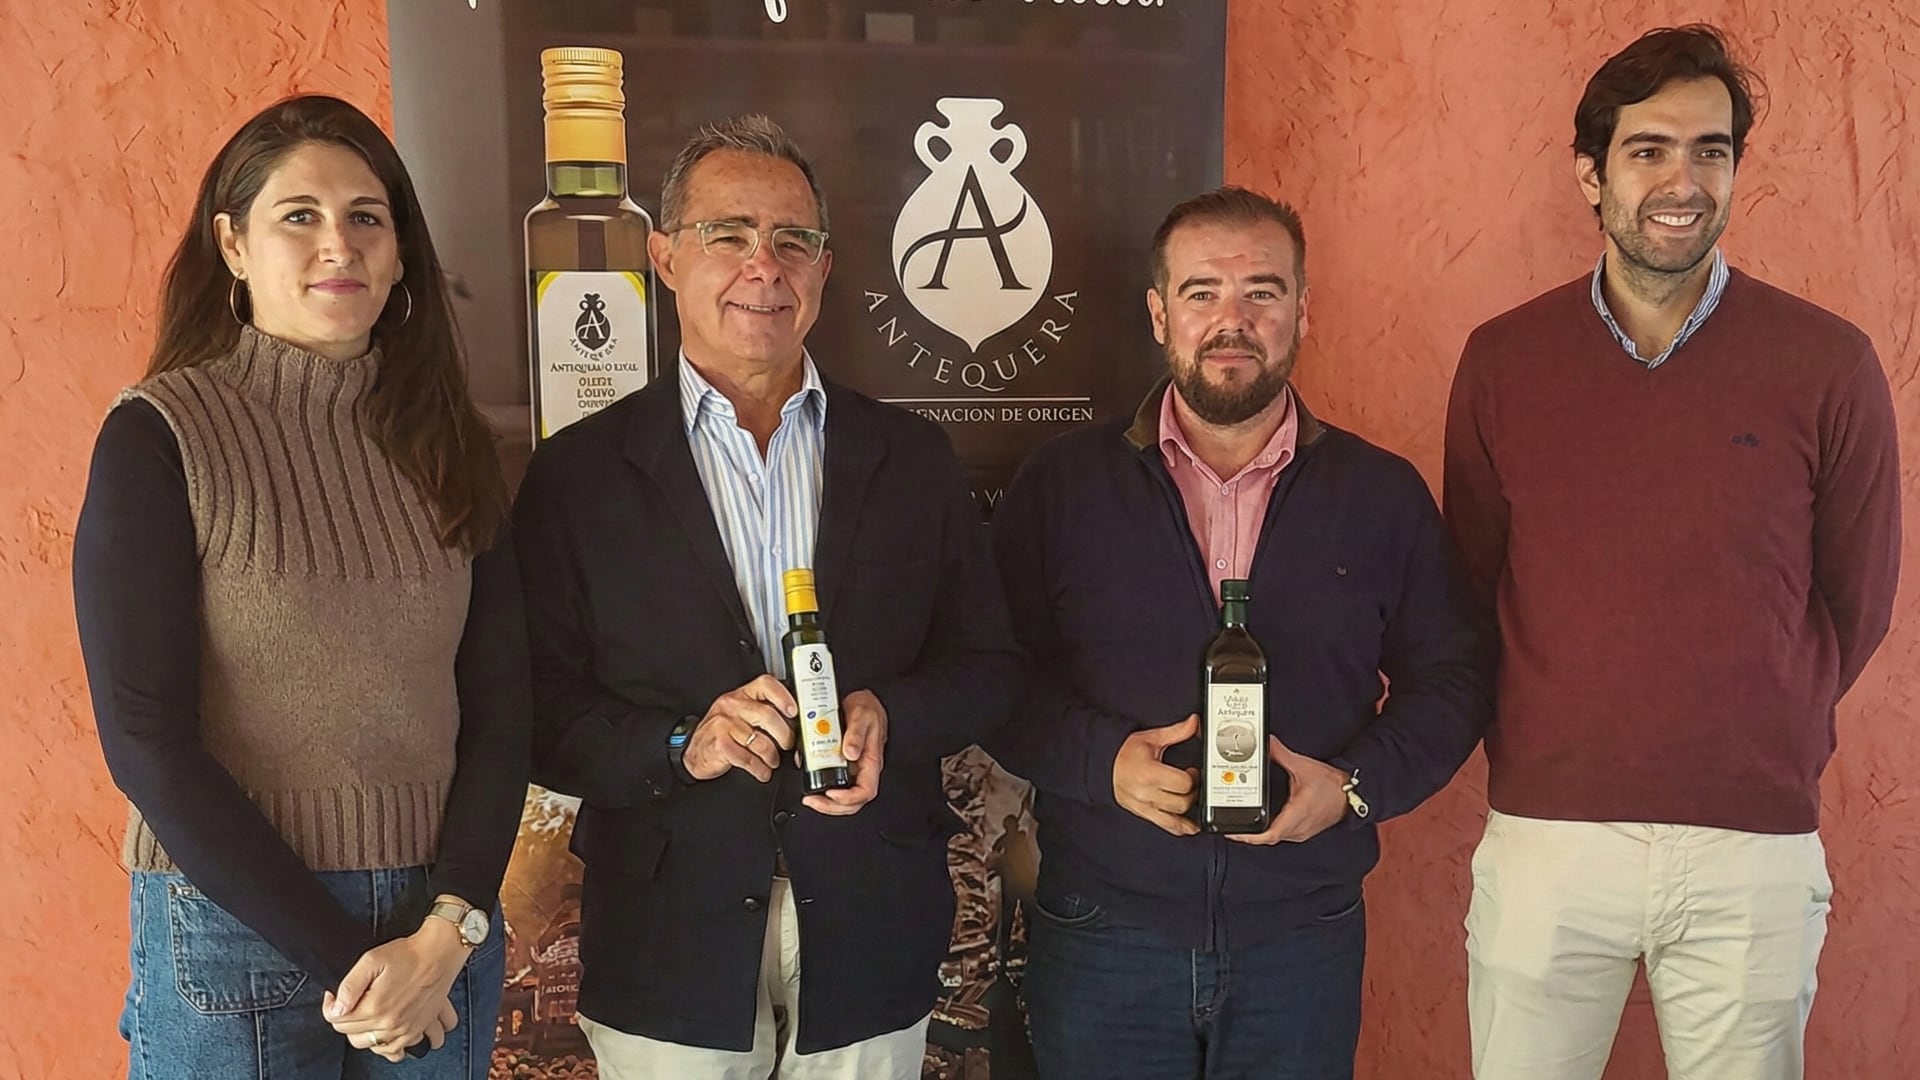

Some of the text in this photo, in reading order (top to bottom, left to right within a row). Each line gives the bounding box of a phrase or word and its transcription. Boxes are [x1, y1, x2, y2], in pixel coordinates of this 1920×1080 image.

[899, 163, 1033, 291] A
[863, 288, 1079, 393] ANTEQUERA
[1001, 407, 1022, 421] DE
[1027, 406, 1094, 421] ORIGEN
